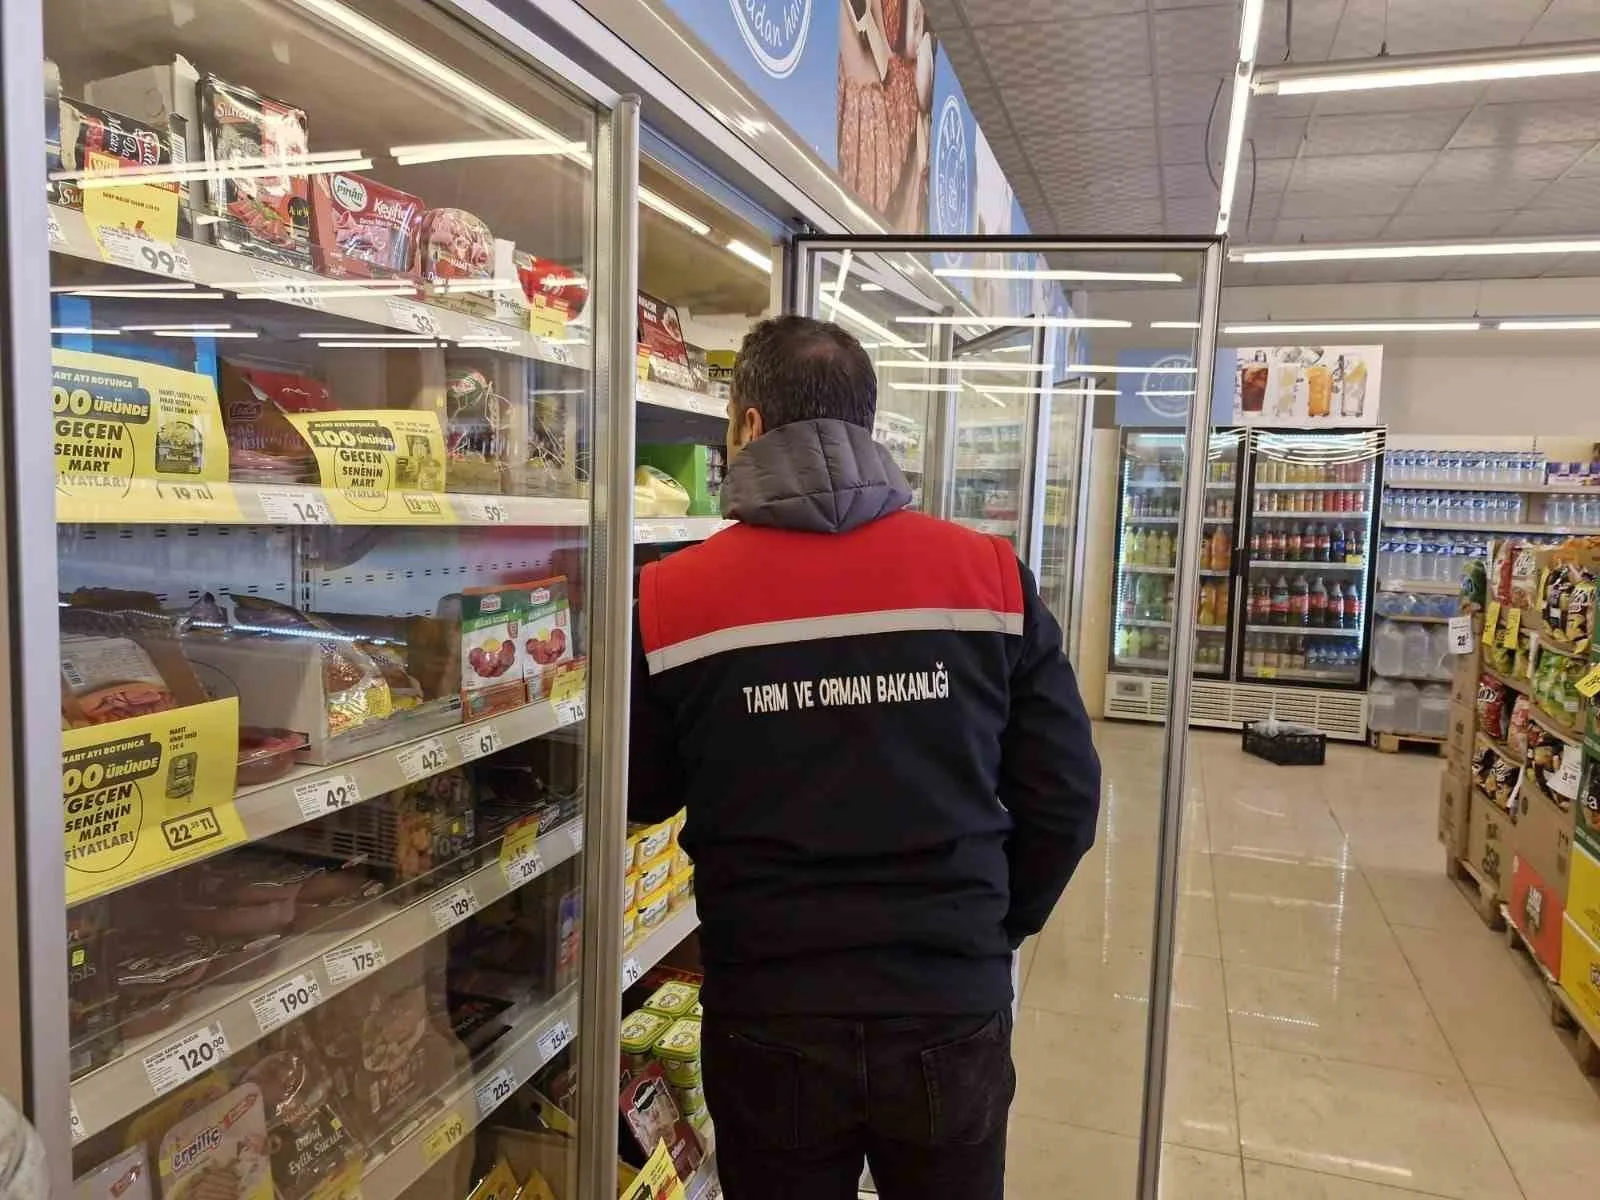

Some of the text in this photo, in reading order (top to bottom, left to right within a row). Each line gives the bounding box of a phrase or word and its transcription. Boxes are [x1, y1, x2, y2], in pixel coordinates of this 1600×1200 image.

[141, 247, 174, 273] 99
[93, 395, 149, 417] ÜRÜNDE
[55, 420, 123, 444] GEÇEN
[312, 430, 356, 447] 100
[69, 459, 110, 472] MART
[340, 450, 381, 465] GEÇEN
[342, 465, 383, 478] SENENİN
[351, 478, 376, 488] MART
[293, 503, 319, 521] 14
[742, 661, 949, 713] TARIM VE ORMAN BAKANLIĞI
[103, 739, 145, 754] BOYUNCA
[480, 736, 493, 754] 67
[106, 757, 160, 779] ÜRÜNDE
[423, 750, 441, 770] 42
[67, 783, 134, 813] GEÇEN
[326, 786, 351, 809] 42
[64, 803, 131, 833] SENENİN
[200, 817, 214, 830] TL
[79, 821, 119, 842] MART
[64, 831, 134, 862] FİYATLARI
[521, 859, 536, 878] 239
[451, 899, 469, 917] 129
[352, 952, 374, 971] 175
[279, 987, 309, 1014] 190
[178, 1042, 213, 1072] 120
[493, 1080, 510, 1101] 225
